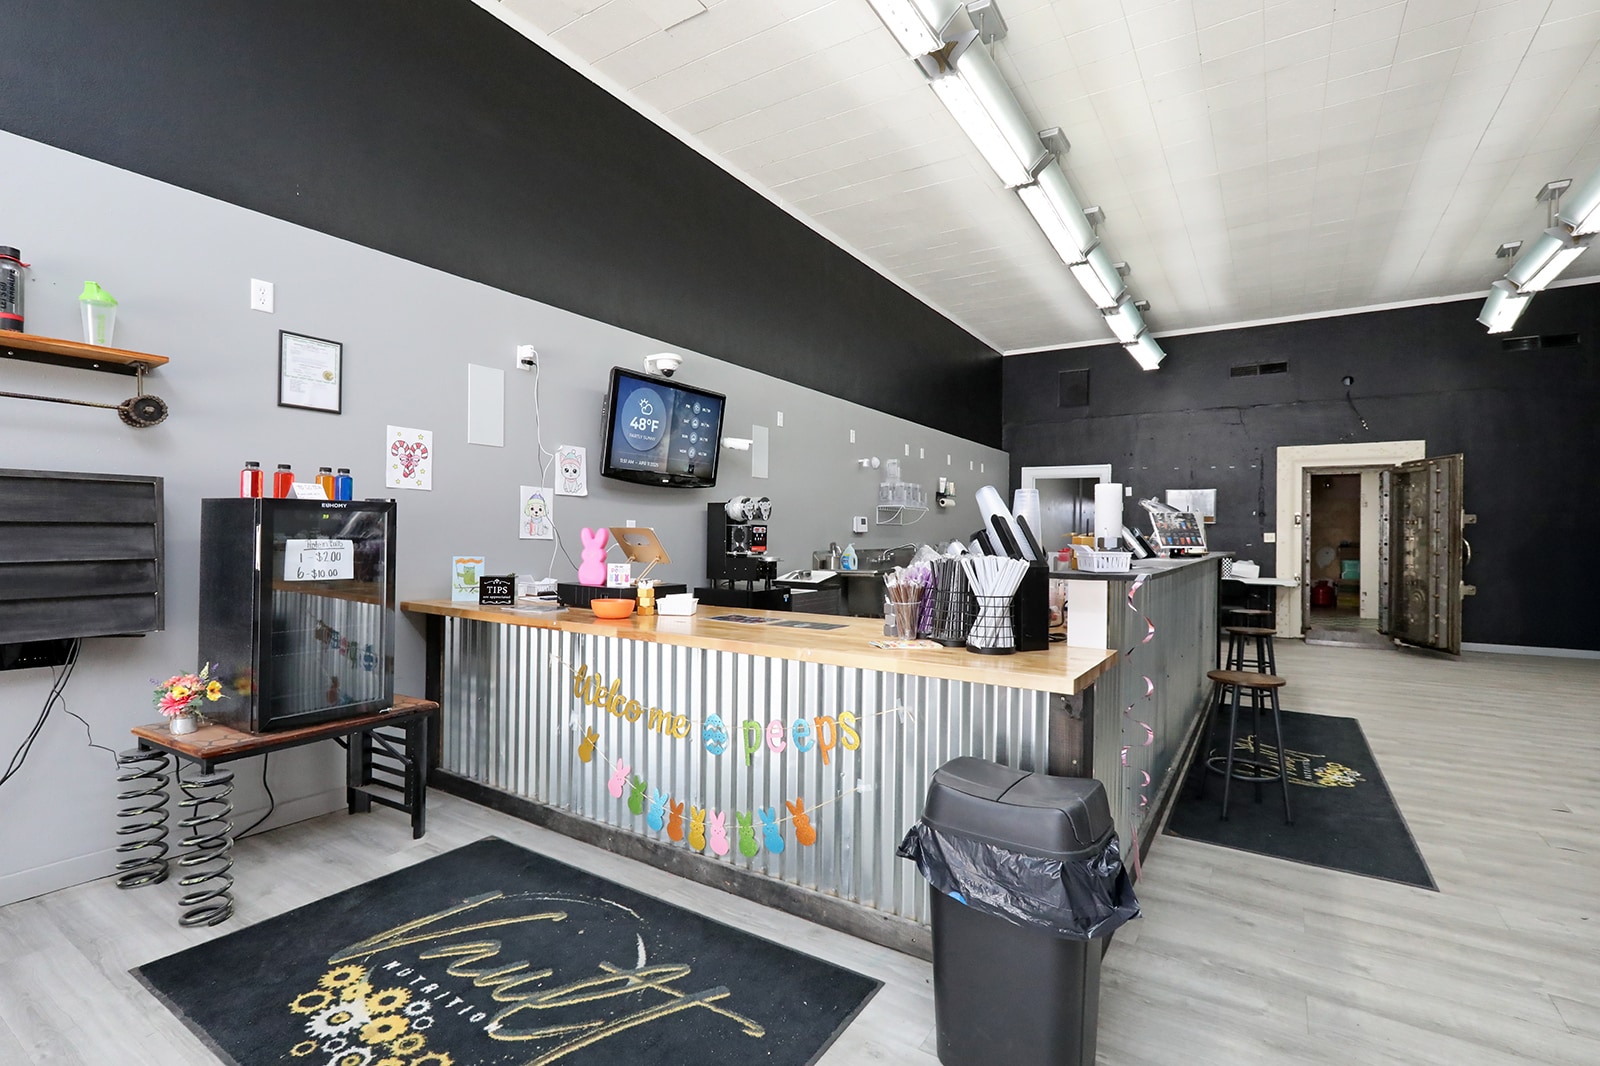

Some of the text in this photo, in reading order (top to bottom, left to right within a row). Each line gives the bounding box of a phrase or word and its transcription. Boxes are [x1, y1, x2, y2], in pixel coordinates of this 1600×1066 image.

[311, 568, 339, 579] $10.00
[487, 586, 508, 594] TIPS
[743, 711, 861, 766] peeps
[382, 959, 504, 1033] NUTRITION
